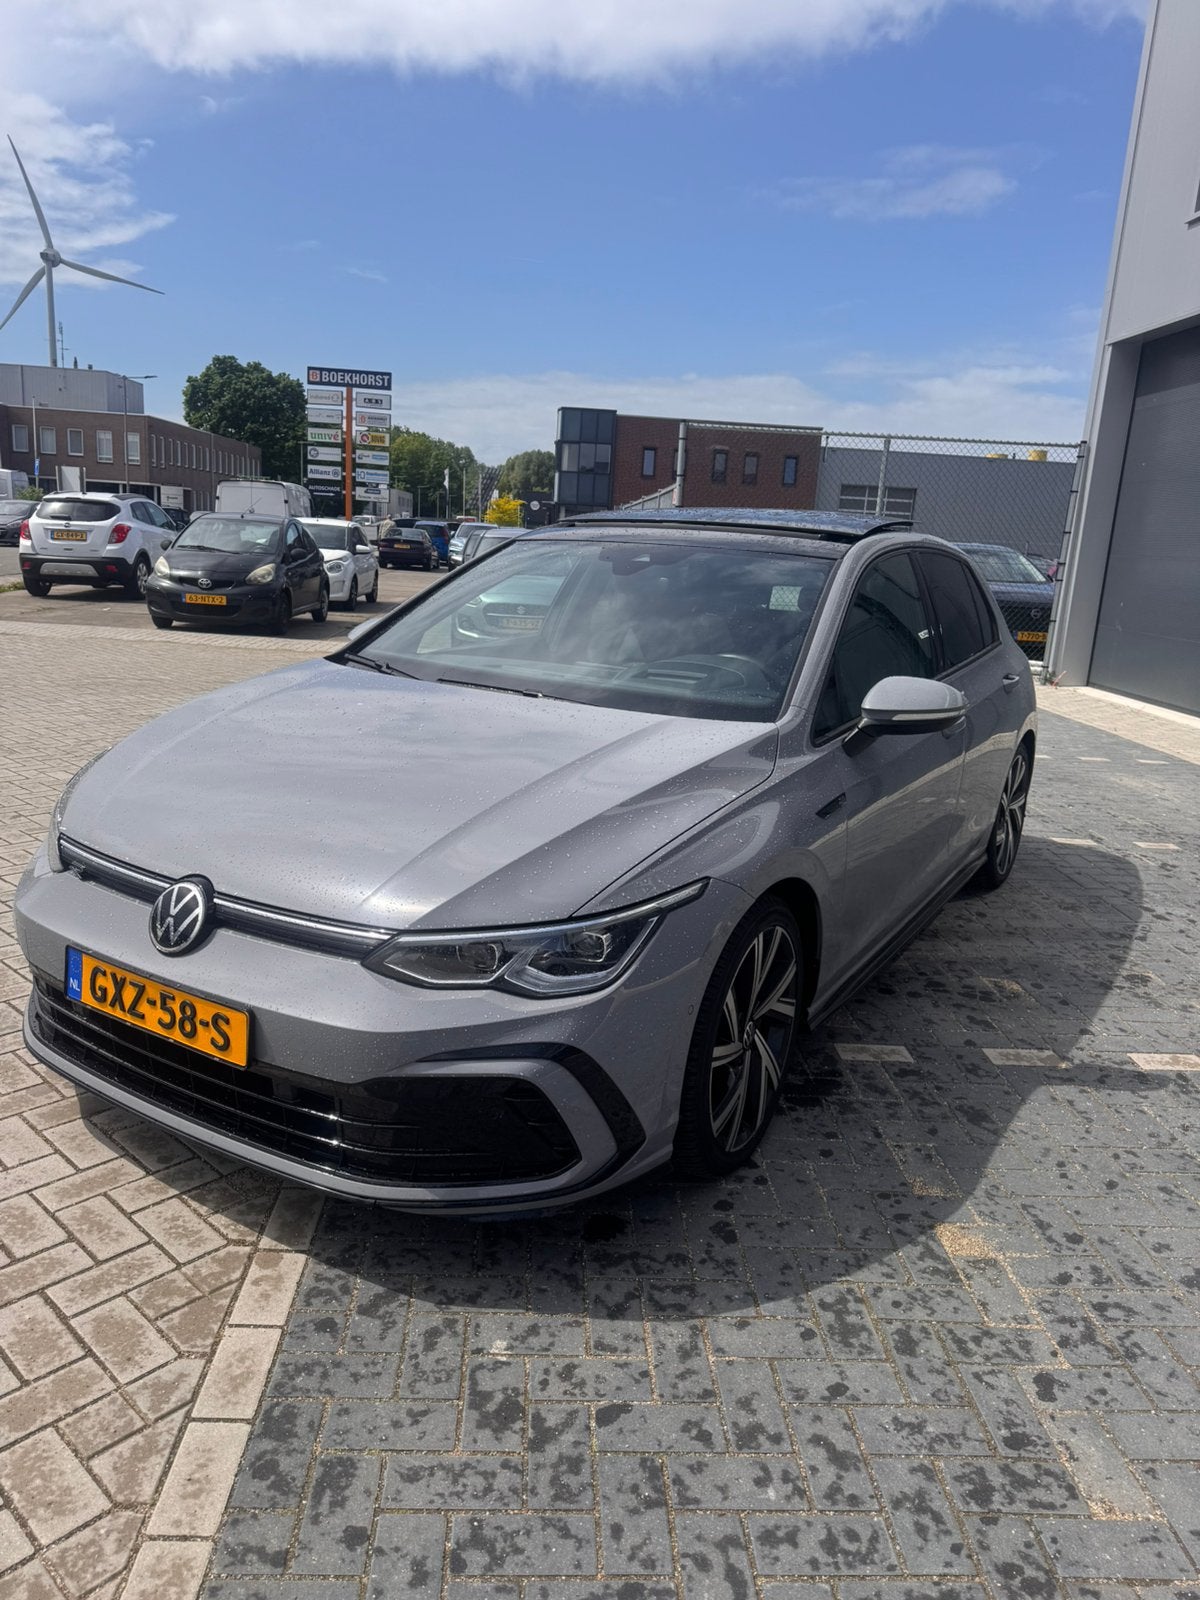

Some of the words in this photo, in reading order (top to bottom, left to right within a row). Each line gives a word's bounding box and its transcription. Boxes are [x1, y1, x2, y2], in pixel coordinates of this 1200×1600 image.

[322, 371, 390, 386] BOEKHORST
[310, 431, 340, 440] univé
[309, 468, 331, 476] Allianz
[189, 594, 224, 603] 63-NTX-2
[69, 977, 80, 991] NL
[89, 965, 231, 1051] GXZ-58-S
